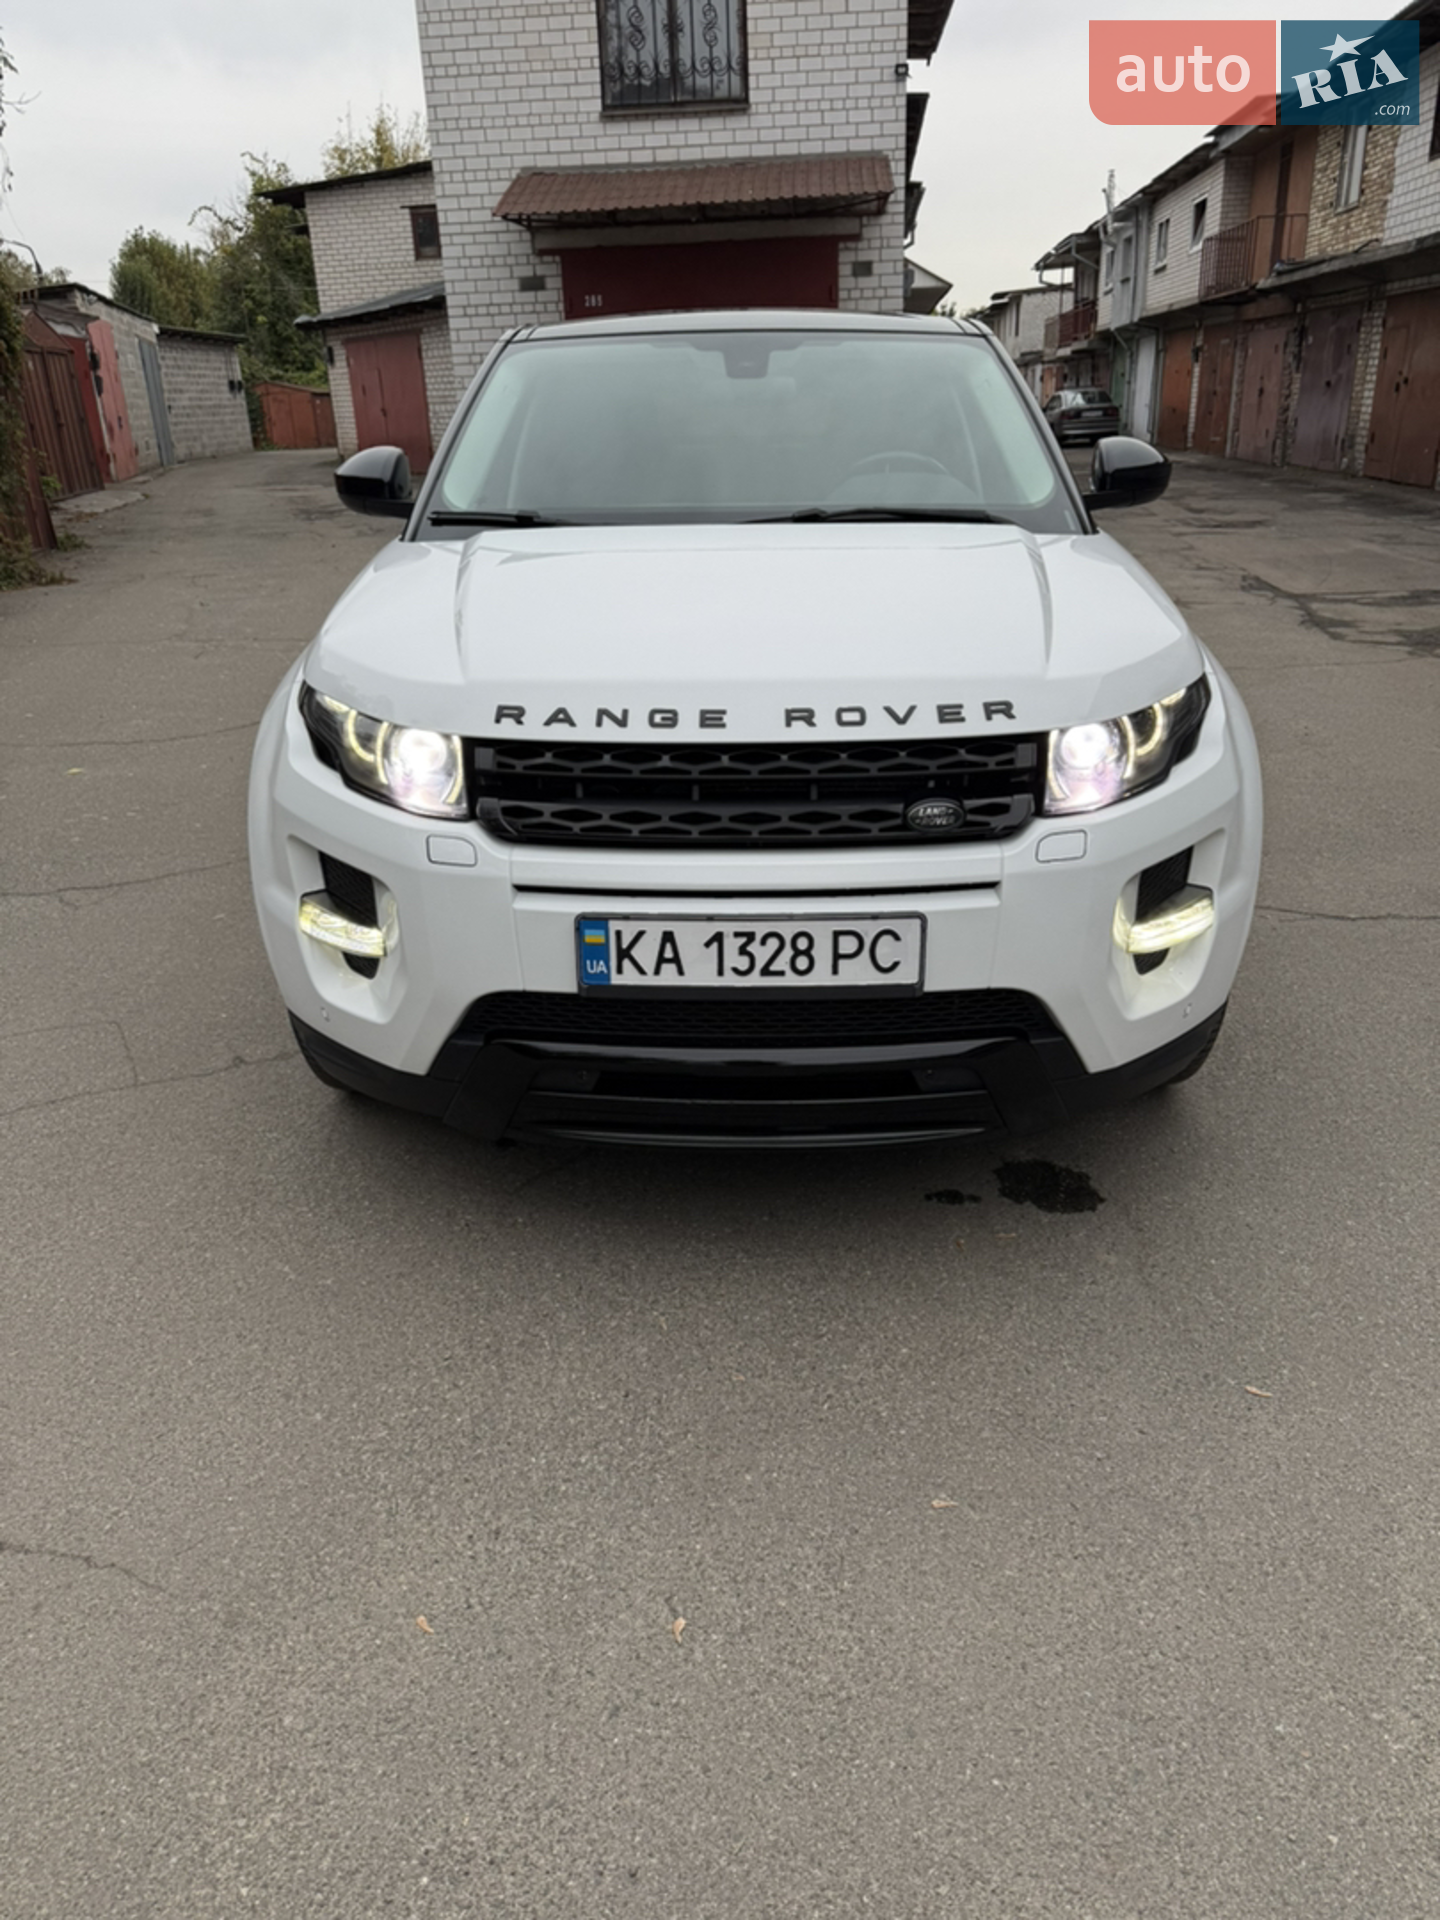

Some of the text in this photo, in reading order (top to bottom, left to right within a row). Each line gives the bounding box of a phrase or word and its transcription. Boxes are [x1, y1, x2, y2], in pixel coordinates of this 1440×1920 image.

[494, 700, 1017, 729] RANGE ROVER
[586, 959, 608, 974] UA
[614, 928, 902, 977] KA 1328 PC
